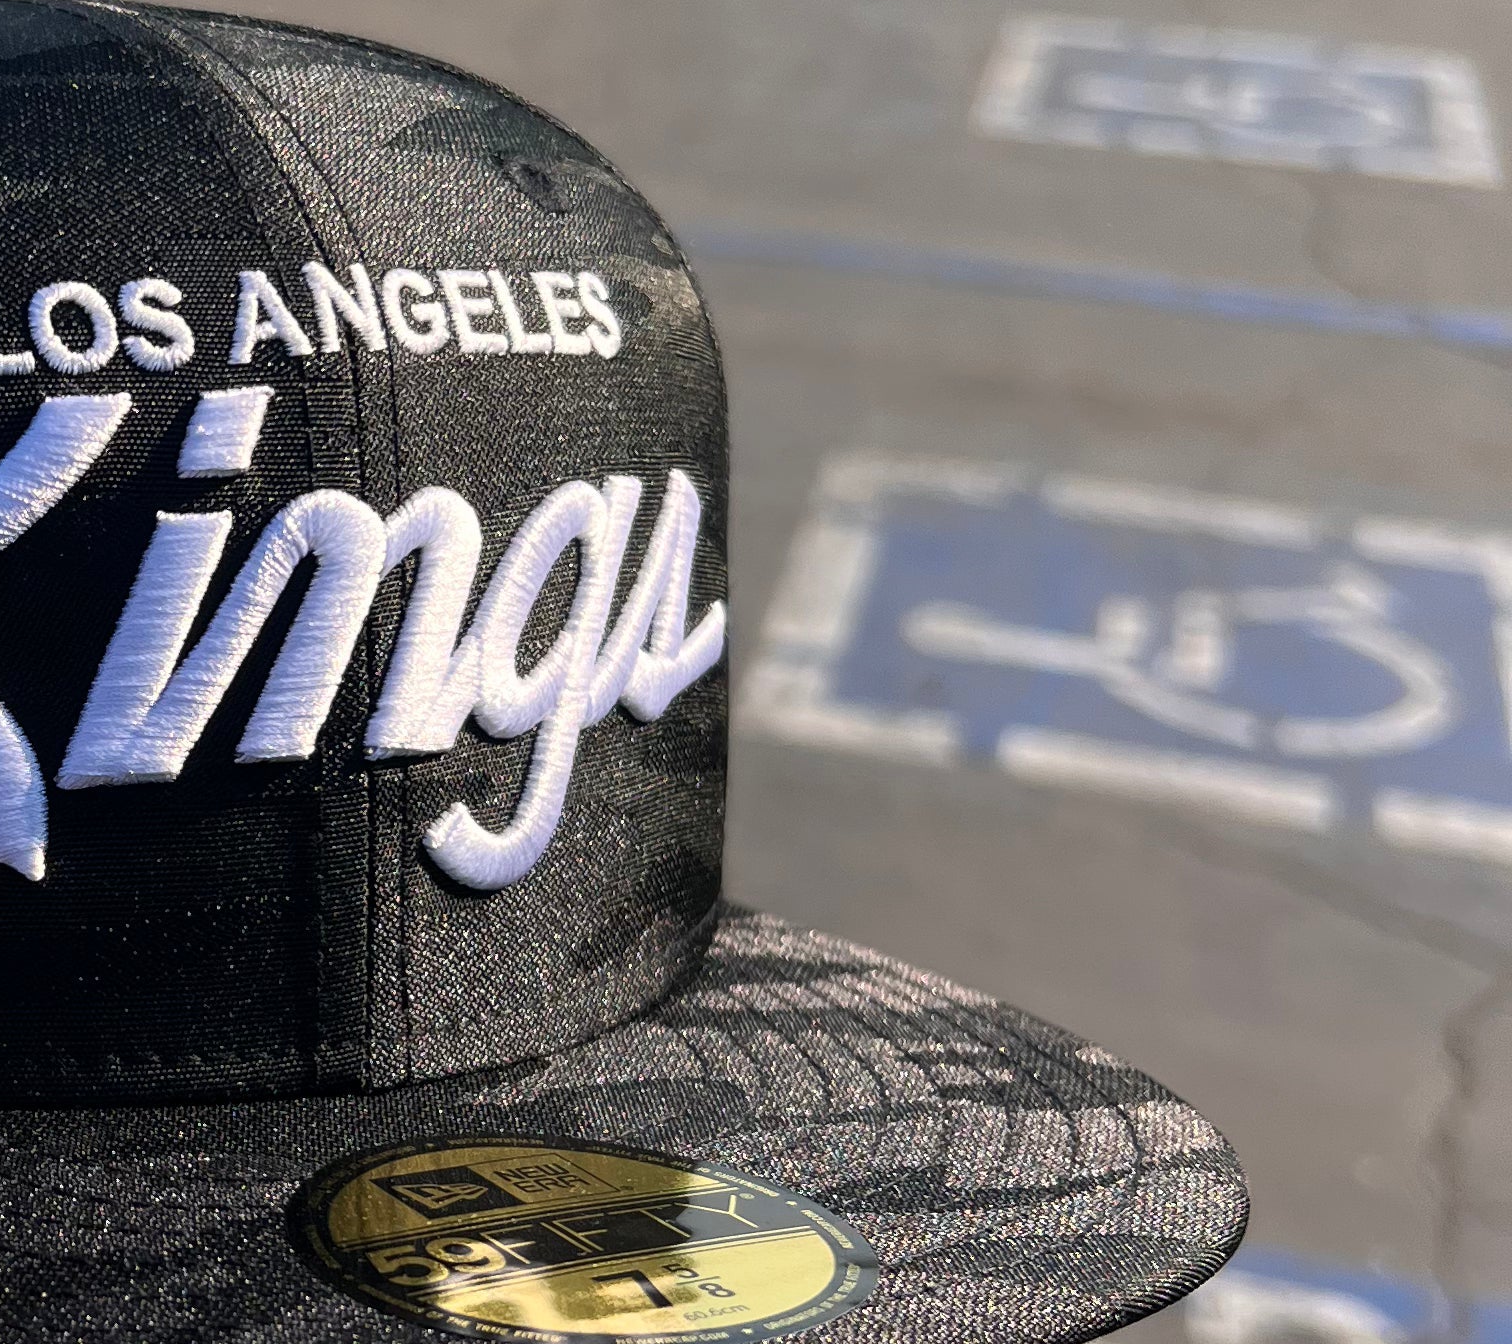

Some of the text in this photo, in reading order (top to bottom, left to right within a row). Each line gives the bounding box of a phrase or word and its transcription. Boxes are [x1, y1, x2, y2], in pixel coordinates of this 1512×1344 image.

[227, 261, 621, 364] ANGELES
[492, 1162, 571, 1183] NEW
[512, 1175, 592, 1194] ERA
[365, 1194, 760, 1287] 59FIFTY
[591, 1269, 674, 1309] 7
[682, 1302, 751, 1322] 60.6cm
